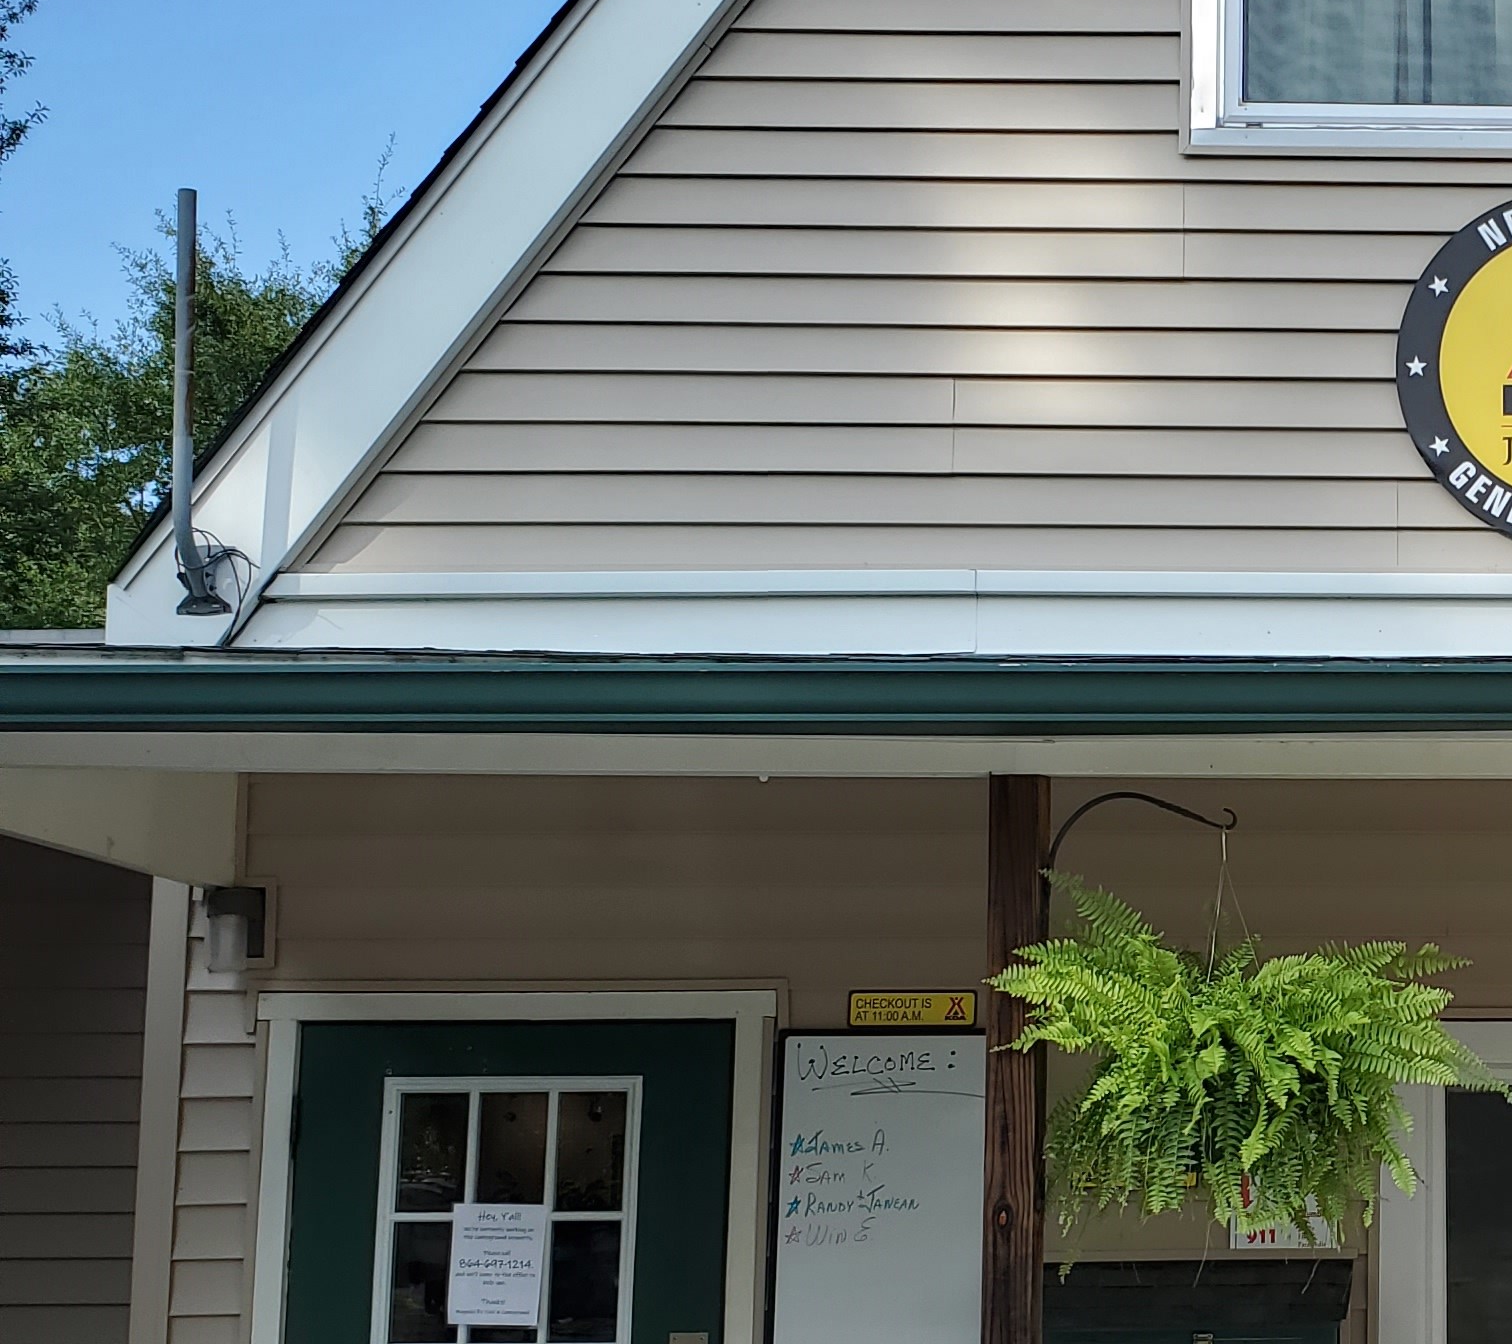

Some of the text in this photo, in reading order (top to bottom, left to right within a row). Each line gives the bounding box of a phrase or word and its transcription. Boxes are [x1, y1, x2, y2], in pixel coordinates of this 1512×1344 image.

[856, 998, 932, 1009] CHECKOUT IS
[855, 1011, 924, 1021] AT 11:00 A.M.
[1246, 1228, 1276, 1244] 911
